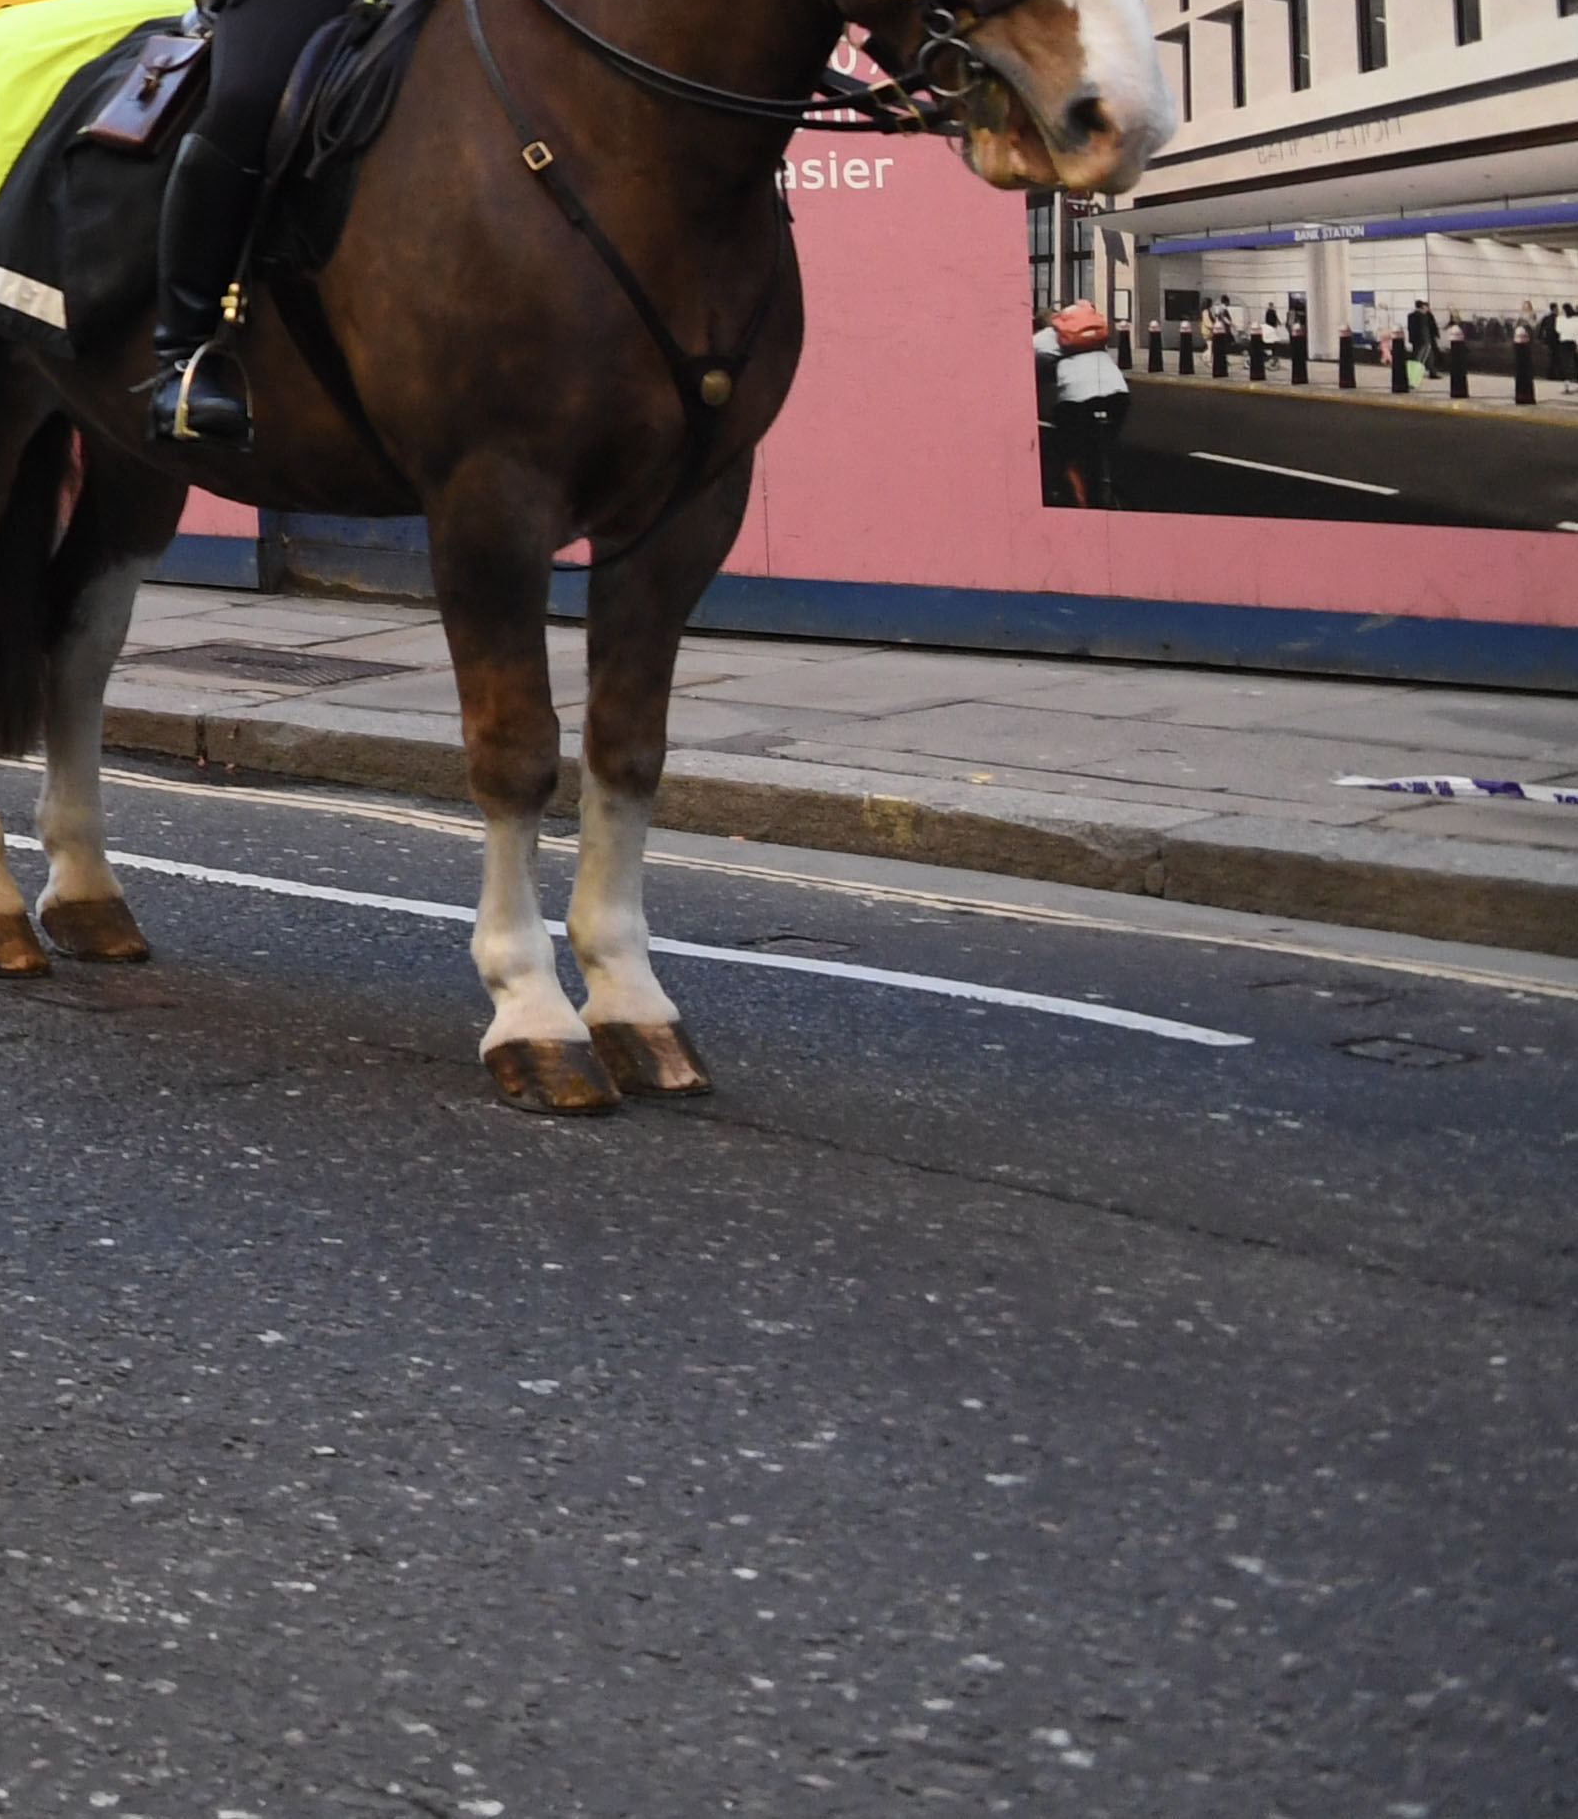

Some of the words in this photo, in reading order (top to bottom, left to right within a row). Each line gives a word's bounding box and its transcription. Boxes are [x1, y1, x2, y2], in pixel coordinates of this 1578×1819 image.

[774, 150, 894, 190] asier
[1295, 228, 1320, 242] BANK
[1321, 224, 1366, 241] STATION
